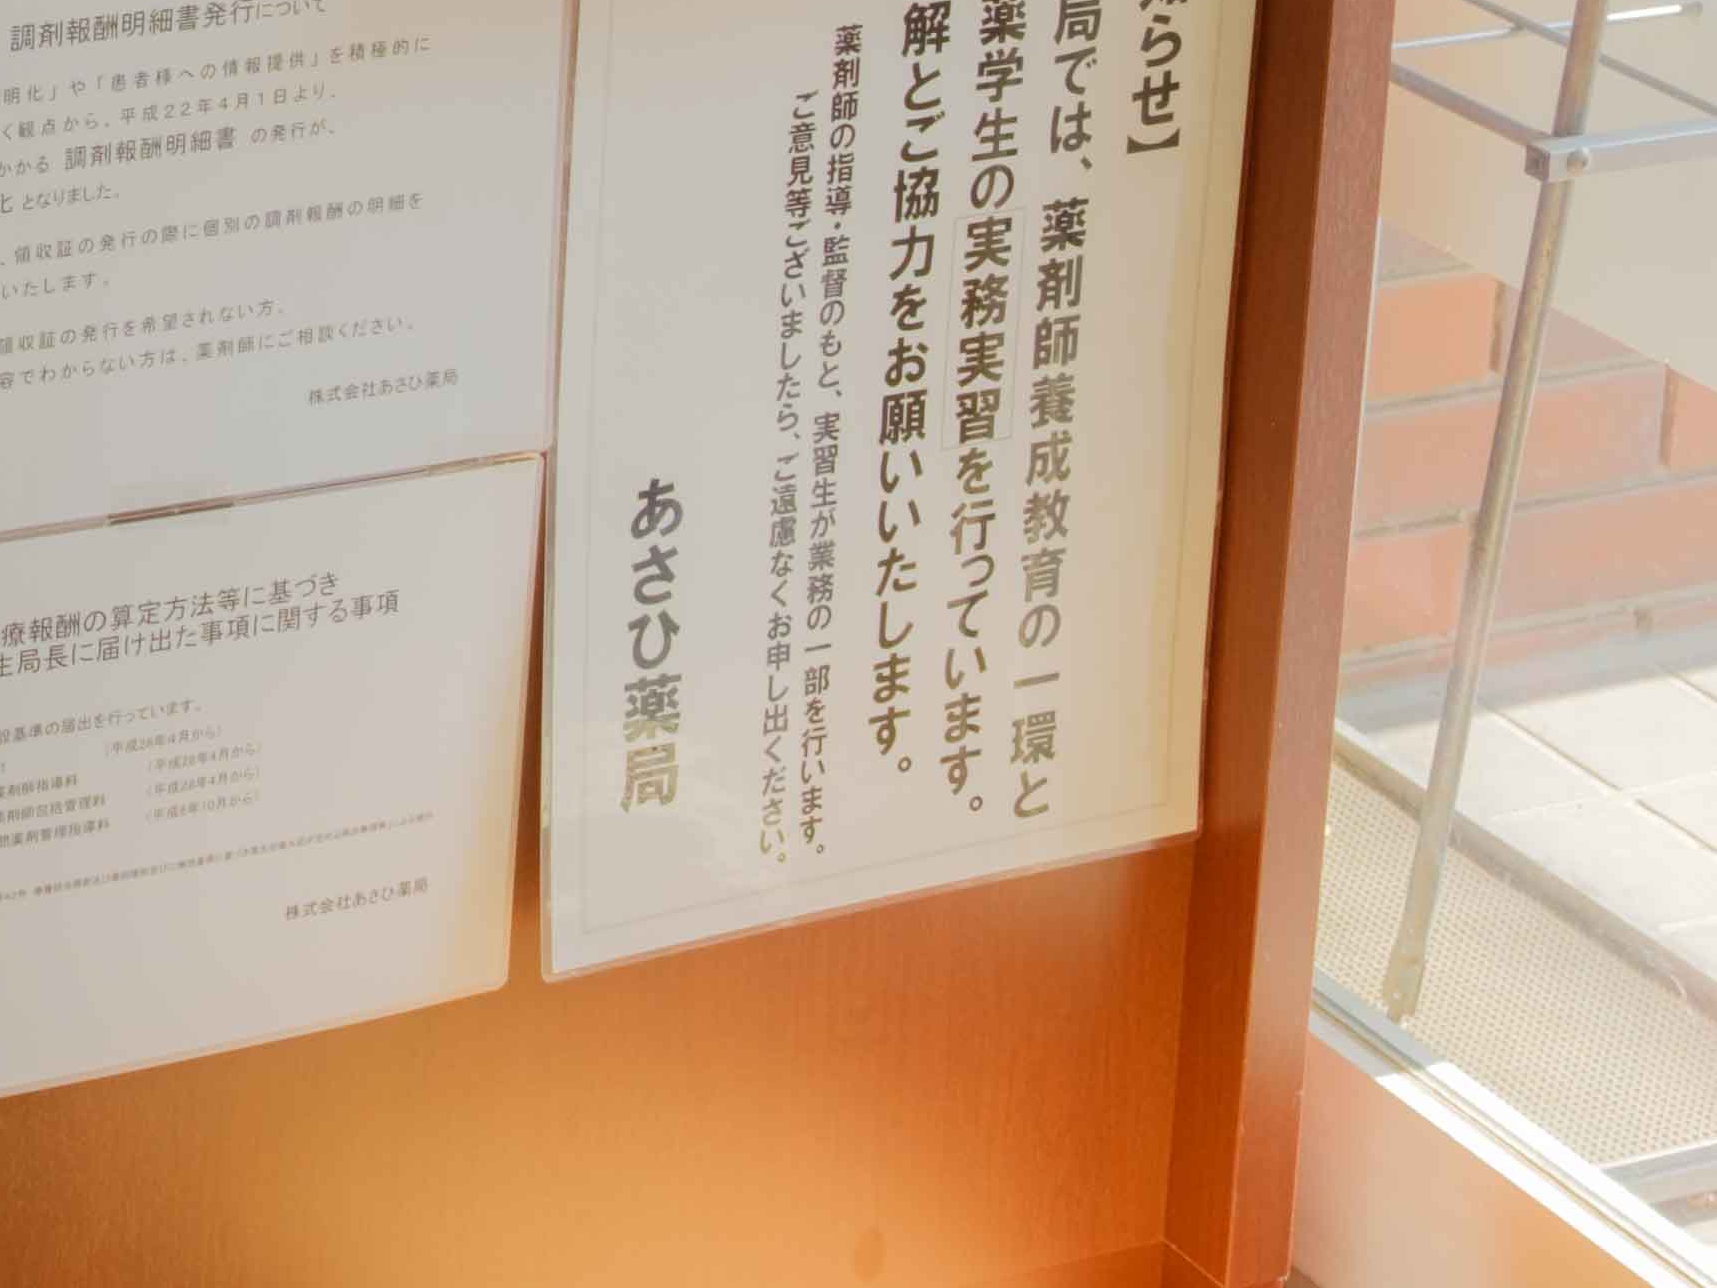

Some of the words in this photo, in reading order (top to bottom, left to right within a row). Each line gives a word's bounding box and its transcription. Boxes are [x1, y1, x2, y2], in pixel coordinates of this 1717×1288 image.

[309, 369, 458, 407] 株式会社あさひ薬局
[621, 478, 683, 813] あさひ薬局
[285, 878, 429, 922] 株式会社あさひ薬局
